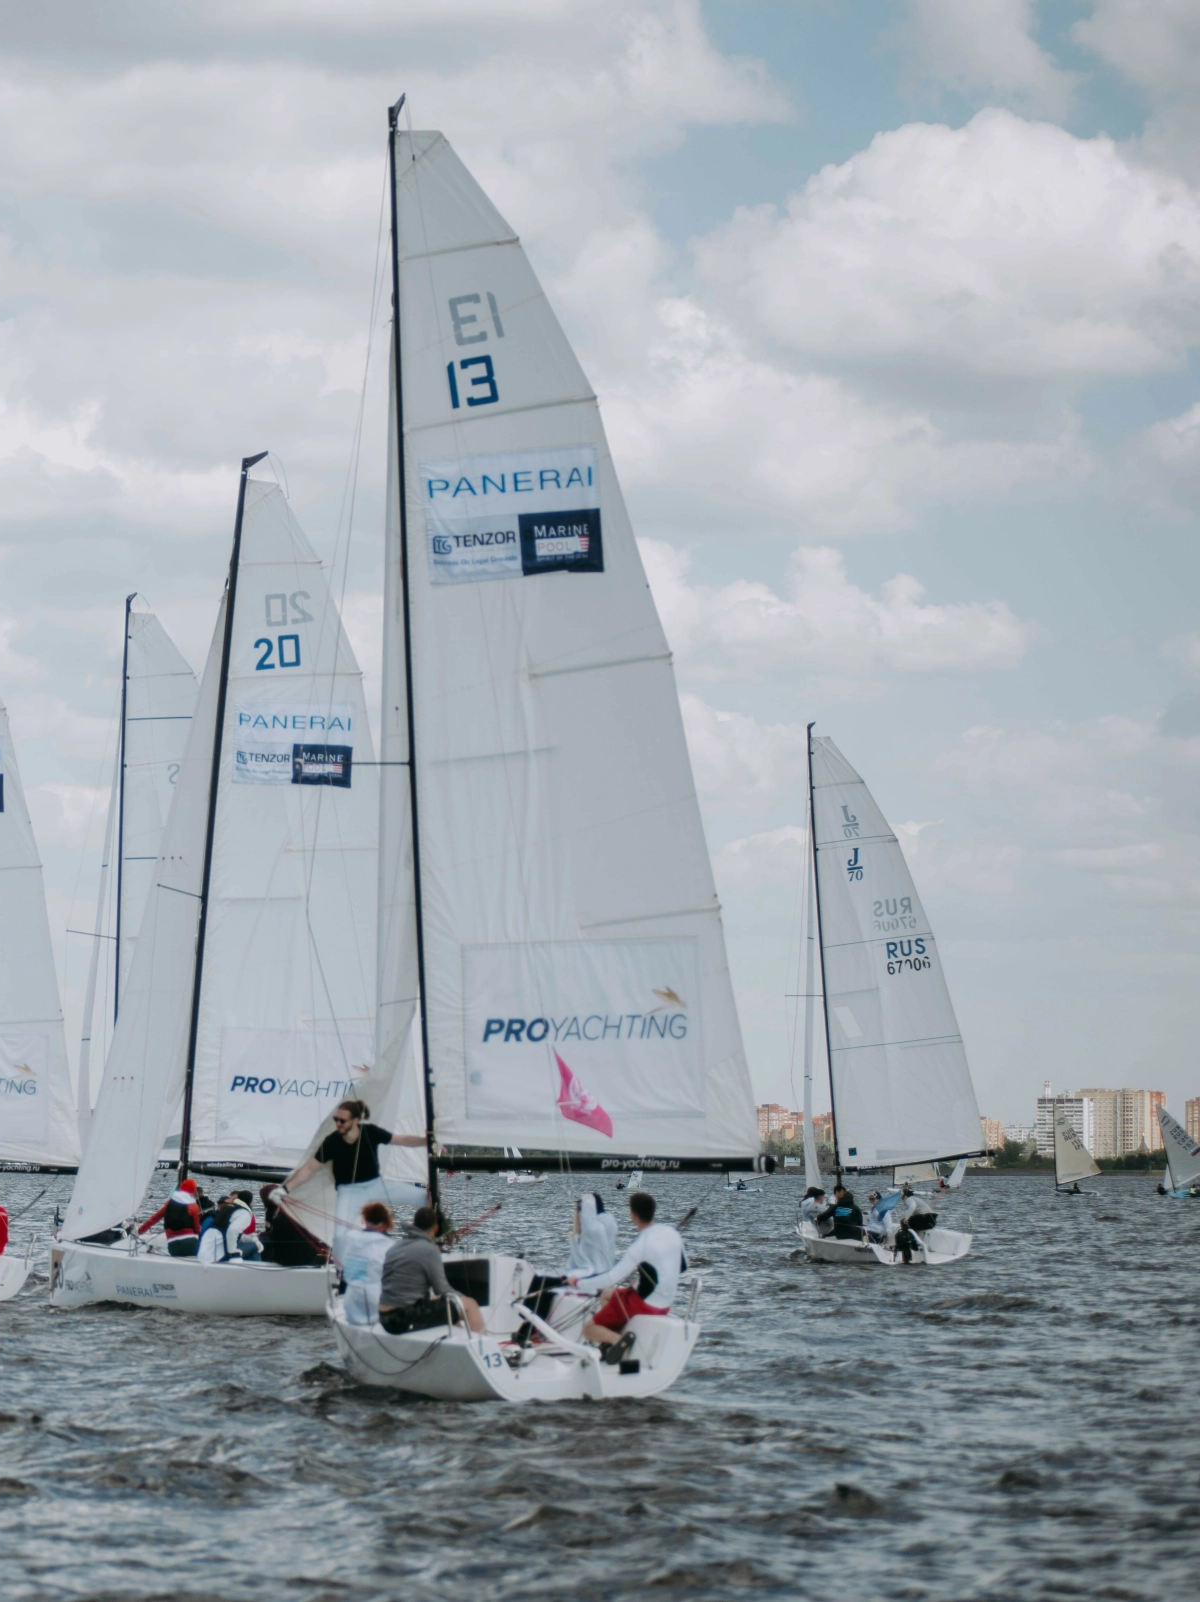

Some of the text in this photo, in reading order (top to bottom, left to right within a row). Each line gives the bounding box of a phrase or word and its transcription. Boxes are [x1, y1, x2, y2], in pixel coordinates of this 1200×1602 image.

[446, 354, 500, 409] 13
[428, 466, 593, 498] PANERAI
[453, 530, 516, 548] TENZOR
[534, 524, 588, 538] MARINE
[537, 541, 572, 553] POOL
[254, 634, 301, 671] 20
[239, 712, 352, 732] PANERAI
[248, 752, 290, 763] TENZOR
[302, 752, 344, 762] MARINE
[847, 848, 859, 866] J
[848, 870, 863, 881] 70
[886, 938, 926, 959] RUS
[482, 1013, 688, 1043] PROYACHTING
[230, 1075, 356, 1098] PROYACHTI
[602, 1158, 680, 1170] pro-yachting.ru
[116, 1285, 153, 1298] PANERAI
[482, 1352, 502, 1369] 13
